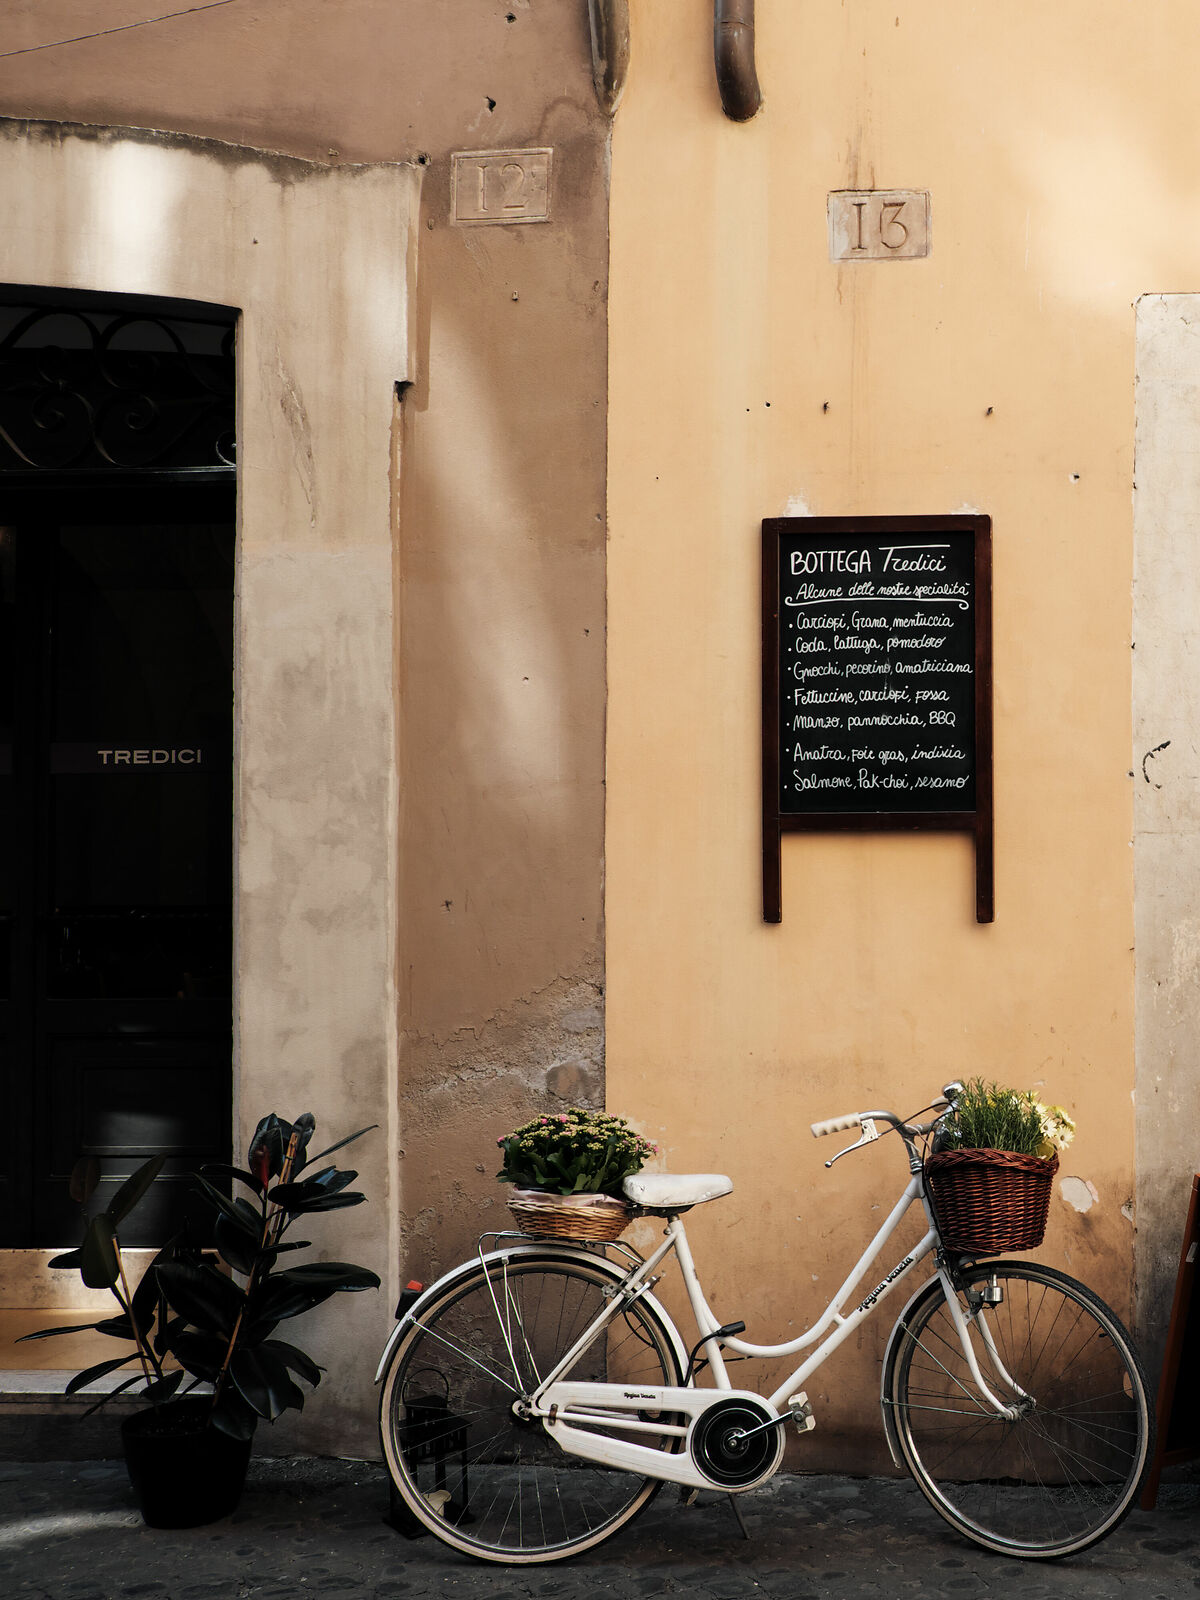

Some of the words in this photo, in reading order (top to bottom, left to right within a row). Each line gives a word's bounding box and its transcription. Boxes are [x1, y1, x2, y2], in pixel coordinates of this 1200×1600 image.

[477, 163, 526, 212] 12
[851, 201, 908, 250] 13
[790, 550, 872, 575] BOTTEGA
[878, 544, 951, 574] Tredici
[796, 583, 843, 600] Alcune
[848, 581, 875, 597] delle
[877, 582, 913, 597] nostre
[796, 611, 850, 632] Carciofi,
[851, 611, 892, 632] Grana,
[892, 611, 955, 629] mentuccia
[795, 636, 831, 653] Coda,
[833, 635, 885, 654] lattuga,
[886, 634, 947, 652] pomodoro
[793, 661, 845, 683] Gnocchi,
[845, 660, 894, 678] pecorino,
[895, 658, 973, 675] amatriciana
[794, 686, 858, 706] Fettuccine,
[858, 685, 912, 704] carciofi,
[793, 714, 844, 731] Manzo,
[847, 713, 926, 731] pannocchia,
[928, 710, 957, 727] BBQ
[97, 749, 202, 765] TREDICI
[793, 742, 851, 762] Anatra,
[878, 749, 909, 766] gras,
[911, 744, 966, 762] indivia
[793, 769, 857, 792] Salmone,
[914, 774, 970, 790] sesamo
